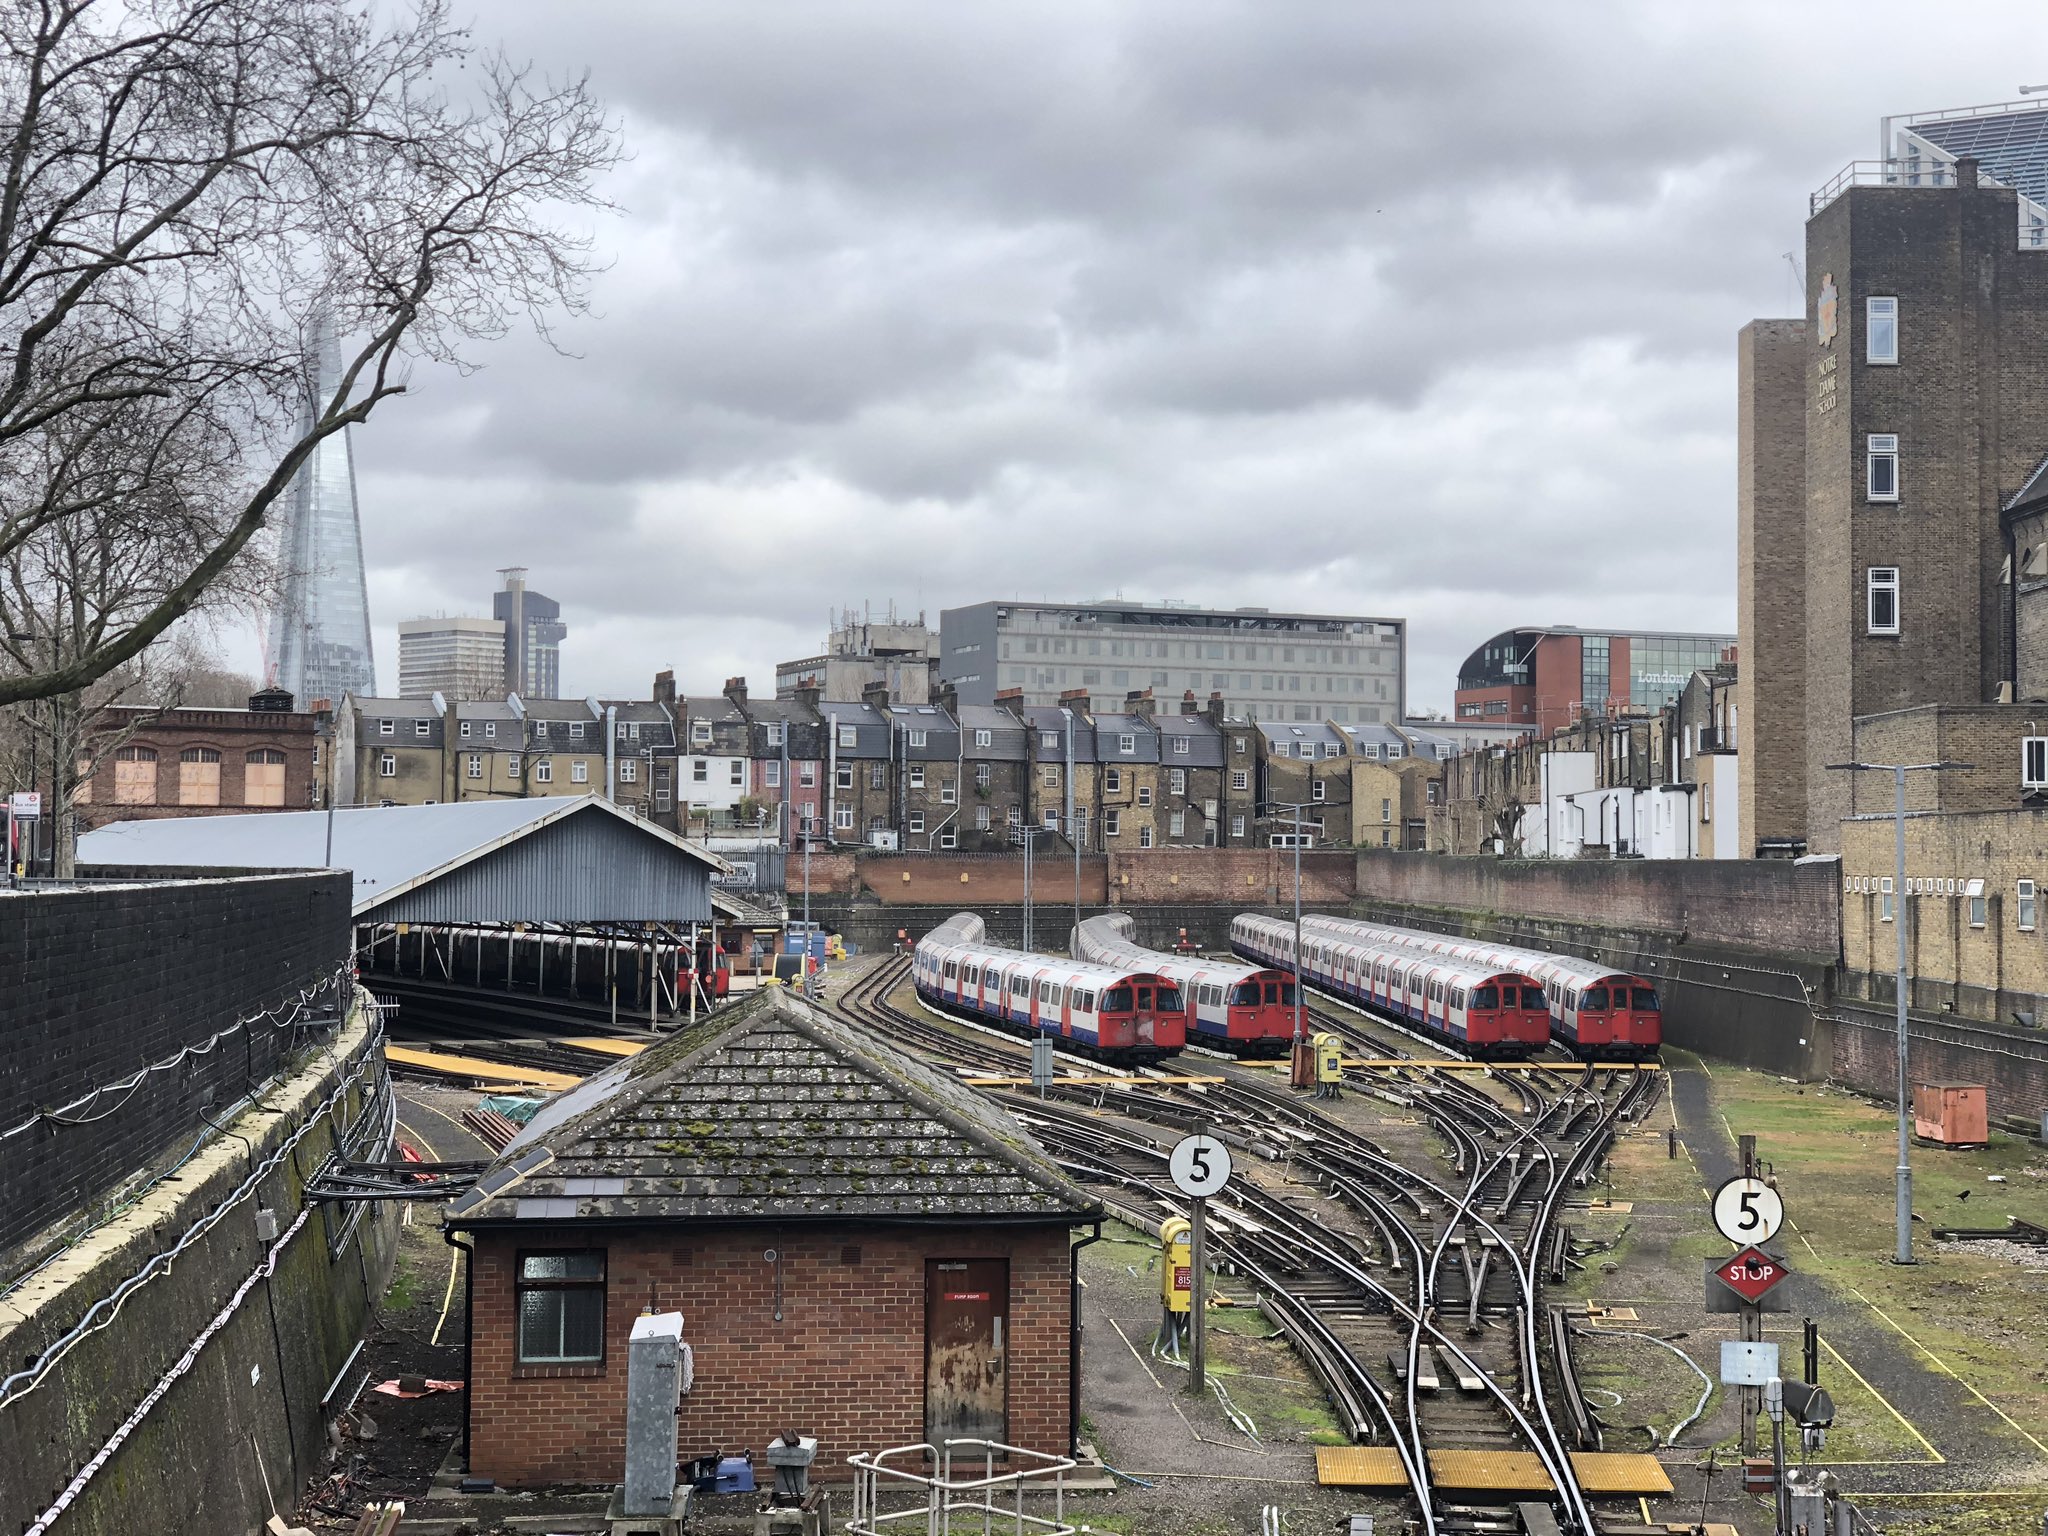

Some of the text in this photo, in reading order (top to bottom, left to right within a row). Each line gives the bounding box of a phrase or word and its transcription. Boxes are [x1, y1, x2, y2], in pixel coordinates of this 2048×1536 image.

[1818, 353, 1837, 378] NOTRE
[1819, 374, 1837, 398] DAME
[1817, 395, 1837, 416] SCHOOL
[1637, 669, 1686, 684] London
[1189, 1147, 1211, 1183] 5
[1737, 1192, 1762, 1231] 5
[1178, 1276, 1191, 1285] 815
[1730, 1265, 1774, 1281] STOP
